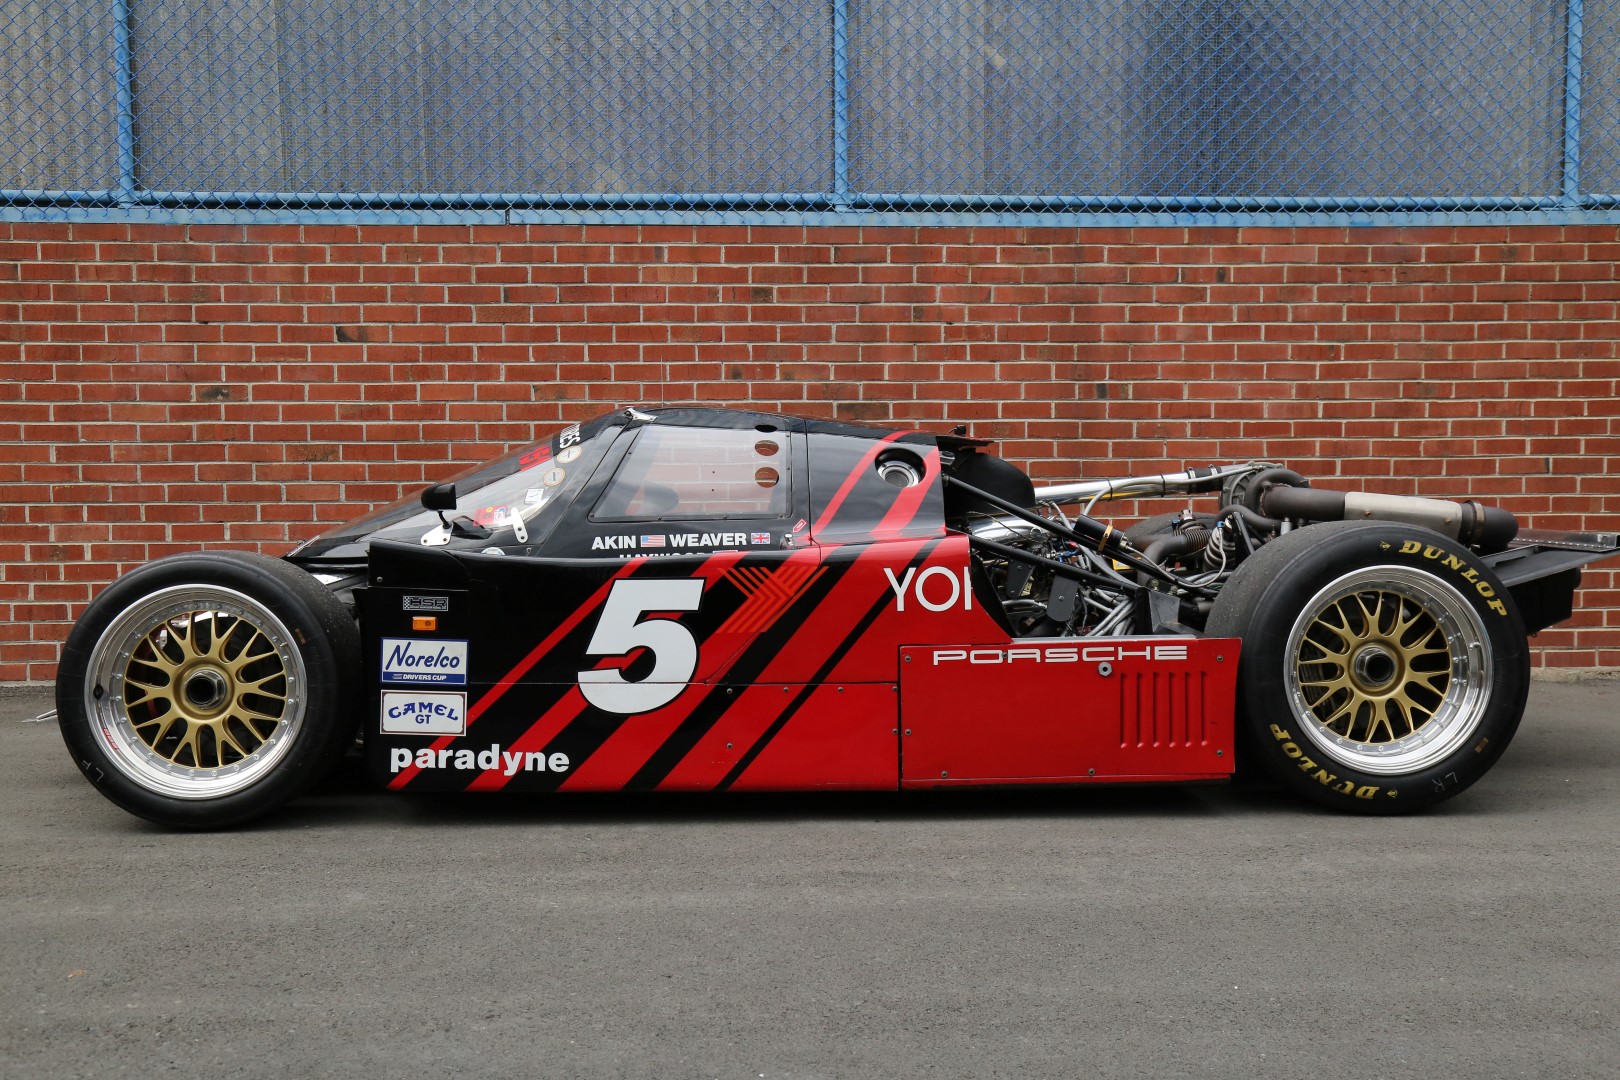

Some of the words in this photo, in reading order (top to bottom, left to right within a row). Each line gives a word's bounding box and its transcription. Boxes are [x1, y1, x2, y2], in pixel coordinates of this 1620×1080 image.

[591, 535, 637, 550] AKIN
[669, 532, 747, 548] WEAVER
[1399, 540, 1508, 616] DUNLOP
[409, 598, 448, 607] HSR
[385, 641, 460, 671] Norelco
[578, 578, 705, 714] 5
[932, 645, 1188, 666] PORSCHE
[402, 673, 432, 681] DRIVERS
[388, 701, 459, 721] CAMEL
[415, 714, 432, 724] GT
[390, 743, 570, 776] paradyne
[1270, 724, 1380, 799] DUNLOP
